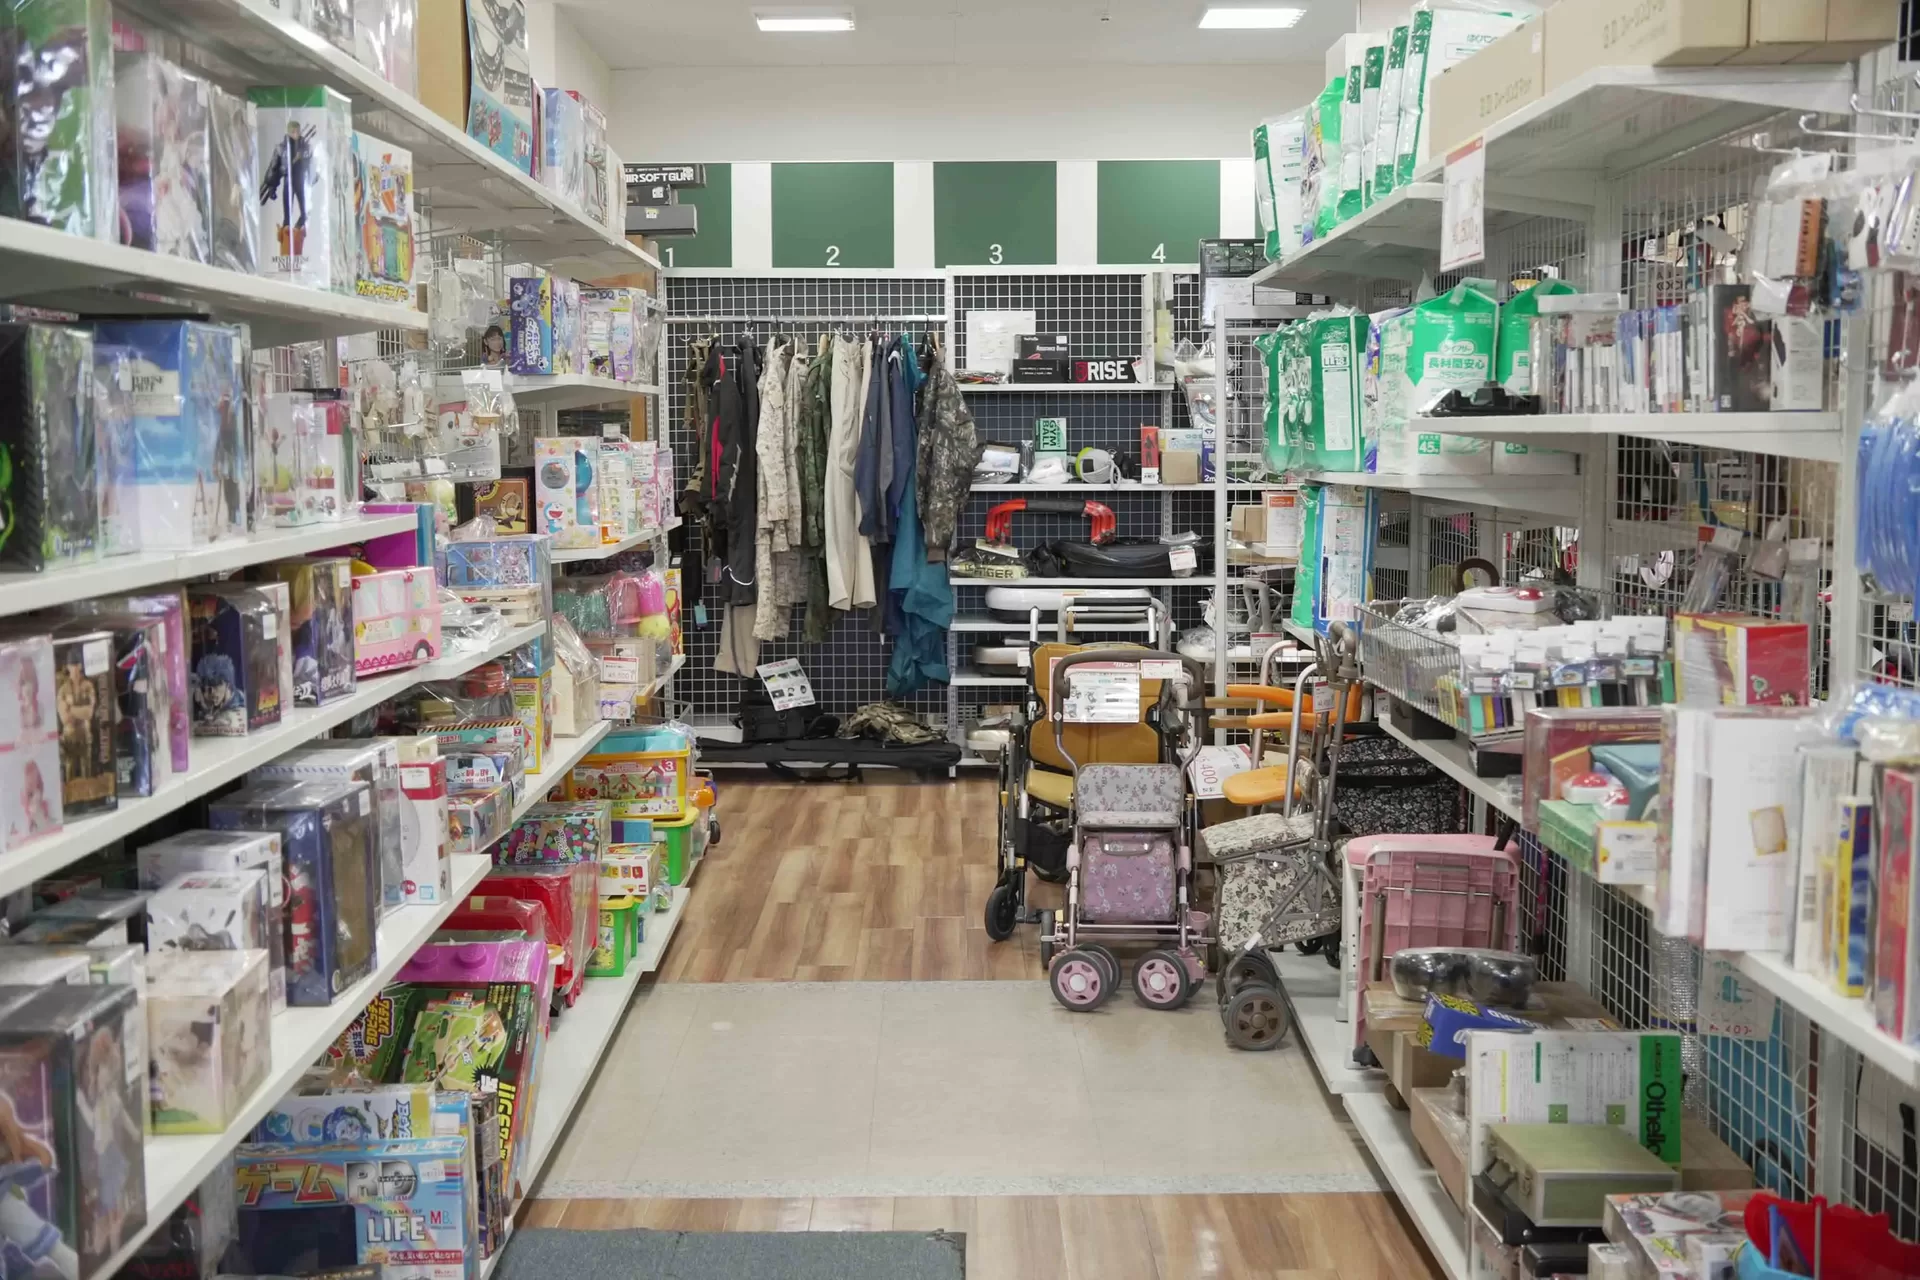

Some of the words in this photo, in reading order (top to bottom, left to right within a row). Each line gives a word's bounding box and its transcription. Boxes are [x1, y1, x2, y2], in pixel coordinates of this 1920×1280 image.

[665, 247, 674, 268] 1
[825, 245, 841, 266] 2
[988, 243, 1004, 265] 3
[1150, 242, 1167, 264] 4
[1087, 360, 1129, 381] RISE
[1042, 419, 1050, 449] BALL
[1049, 419, 1057, 447] GYM
[1646, 1082, 1667, 1156] Othello
[236, 1162, 338, 1205] ゲーム
[367, 1215, 426, 1243] LIFE
